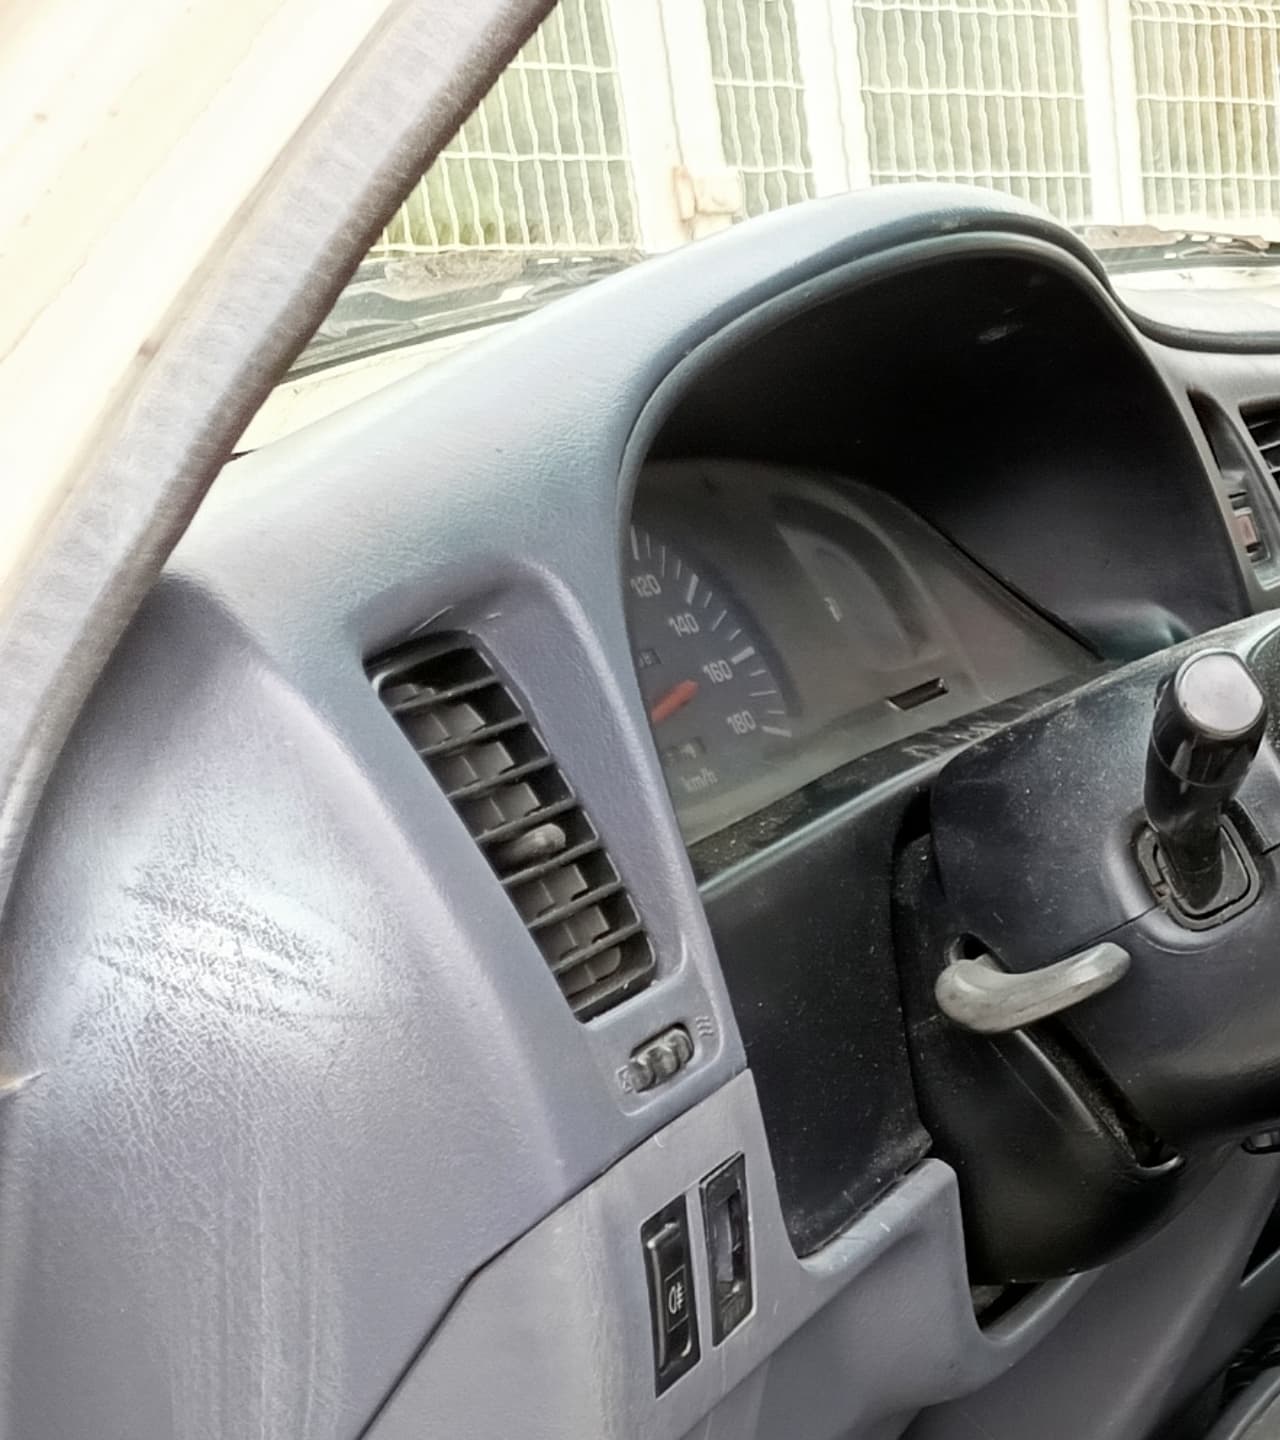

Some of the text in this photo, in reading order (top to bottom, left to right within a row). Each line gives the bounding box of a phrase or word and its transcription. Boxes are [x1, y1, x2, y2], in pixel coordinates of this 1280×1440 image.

[630, 574, 661, 598] 120
[668, 613, 699, 636] 140
[702, 660, 733, 684] 160
[727, 710, 756, 735] 180
[682, 767, 717, 791] km/h
